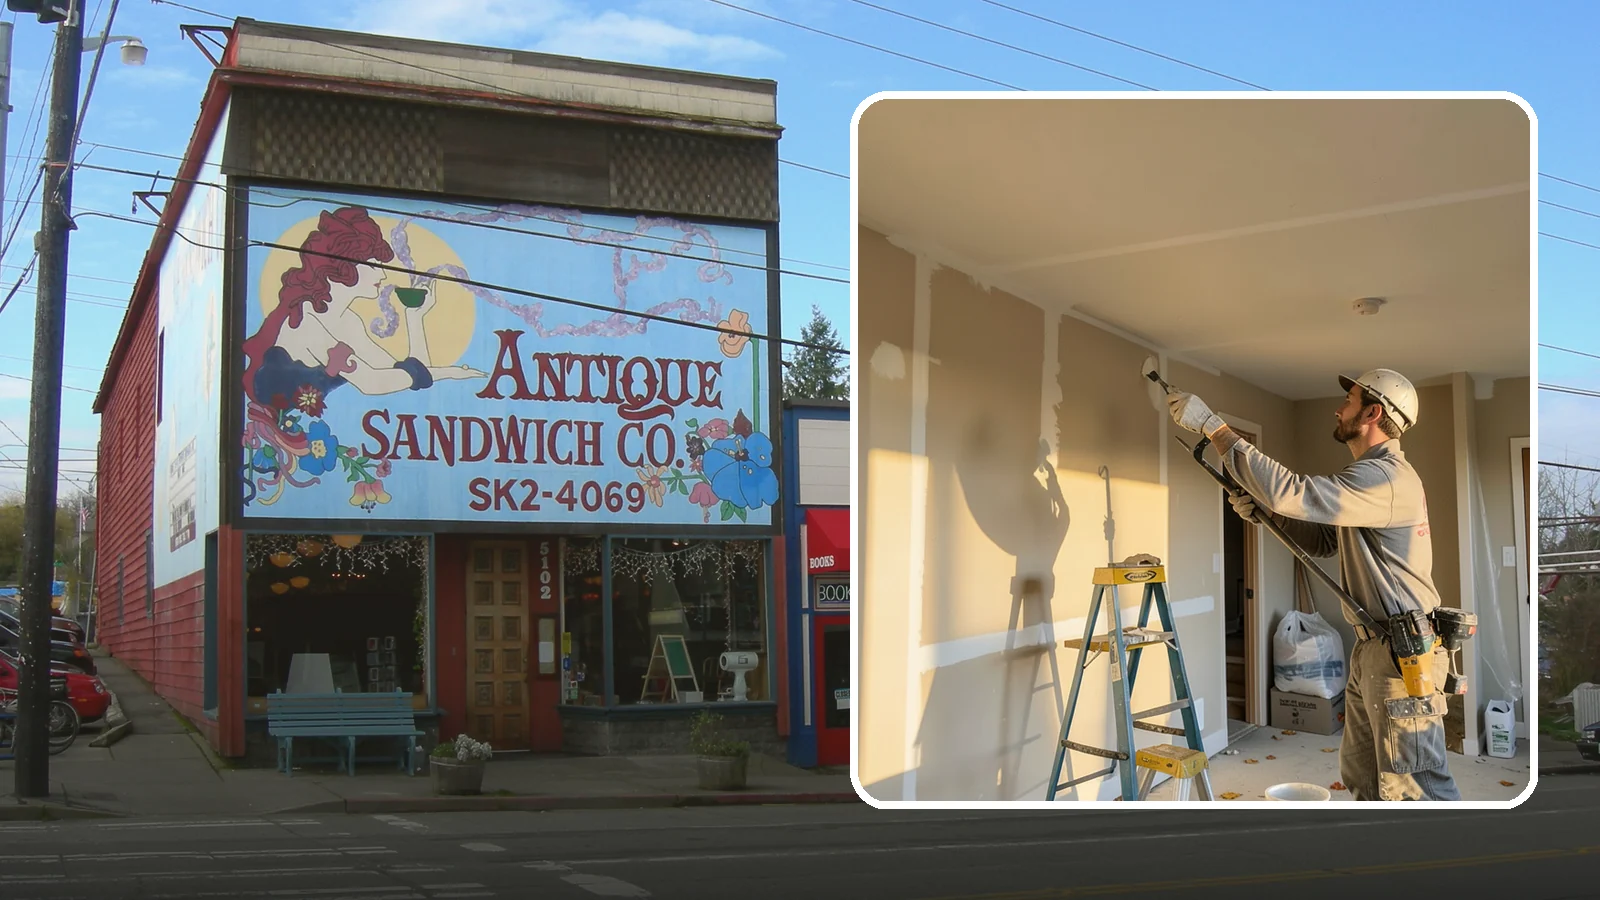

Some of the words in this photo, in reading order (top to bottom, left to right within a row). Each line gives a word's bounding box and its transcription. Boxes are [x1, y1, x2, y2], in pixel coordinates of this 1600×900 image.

[476, 330, 723, 420] ANTIQUE
[361, 409, 604, 467] SANDWICH
[617, 422, 685, 469] CO.
[468, 477, 646, 513] SK2-4069
[540, 541, 551, 600] 5102
[809, 555, 835, 569] BOOKS
